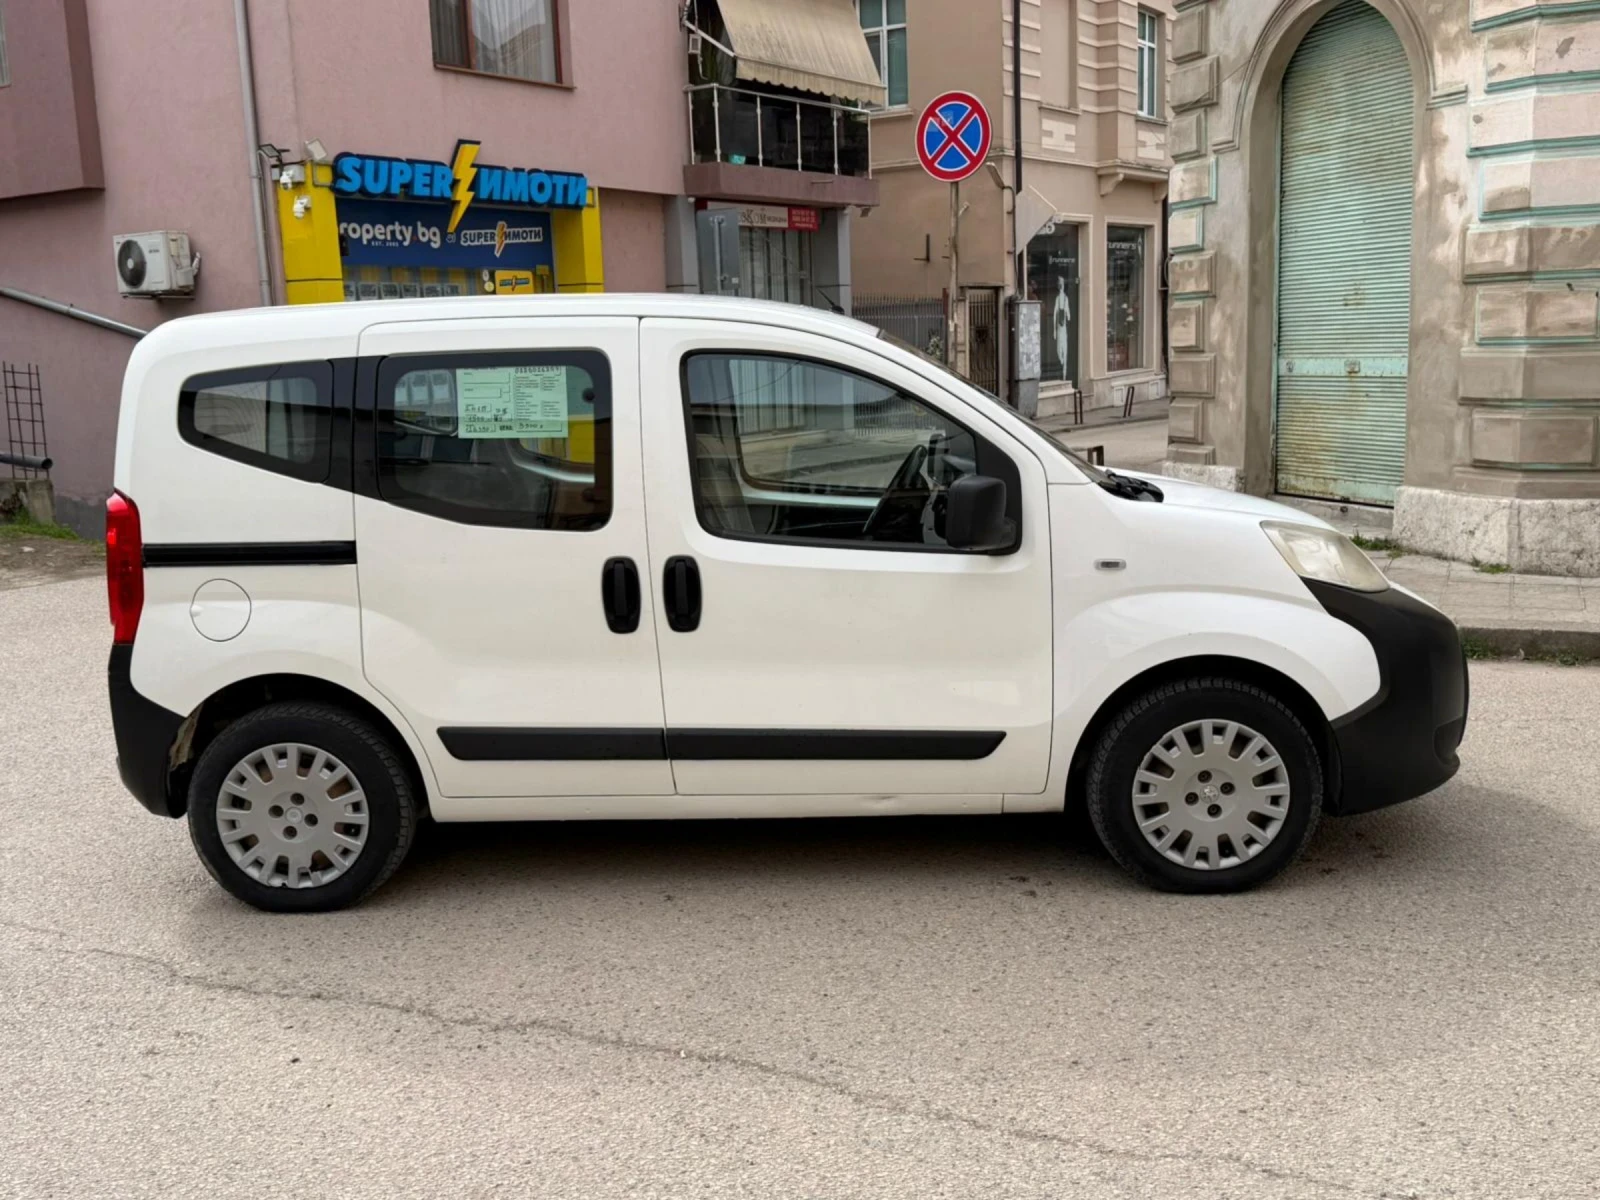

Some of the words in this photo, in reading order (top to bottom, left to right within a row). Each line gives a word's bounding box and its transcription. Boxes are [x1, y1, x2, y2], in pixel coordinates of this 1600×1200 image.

[335, 155, 453, 198] SUPER
[478, 165, 588, 208] ИМОТИ
[462, 231, 496, 244] SUPER
[504, 228, 542, 242] ИМОТИ
